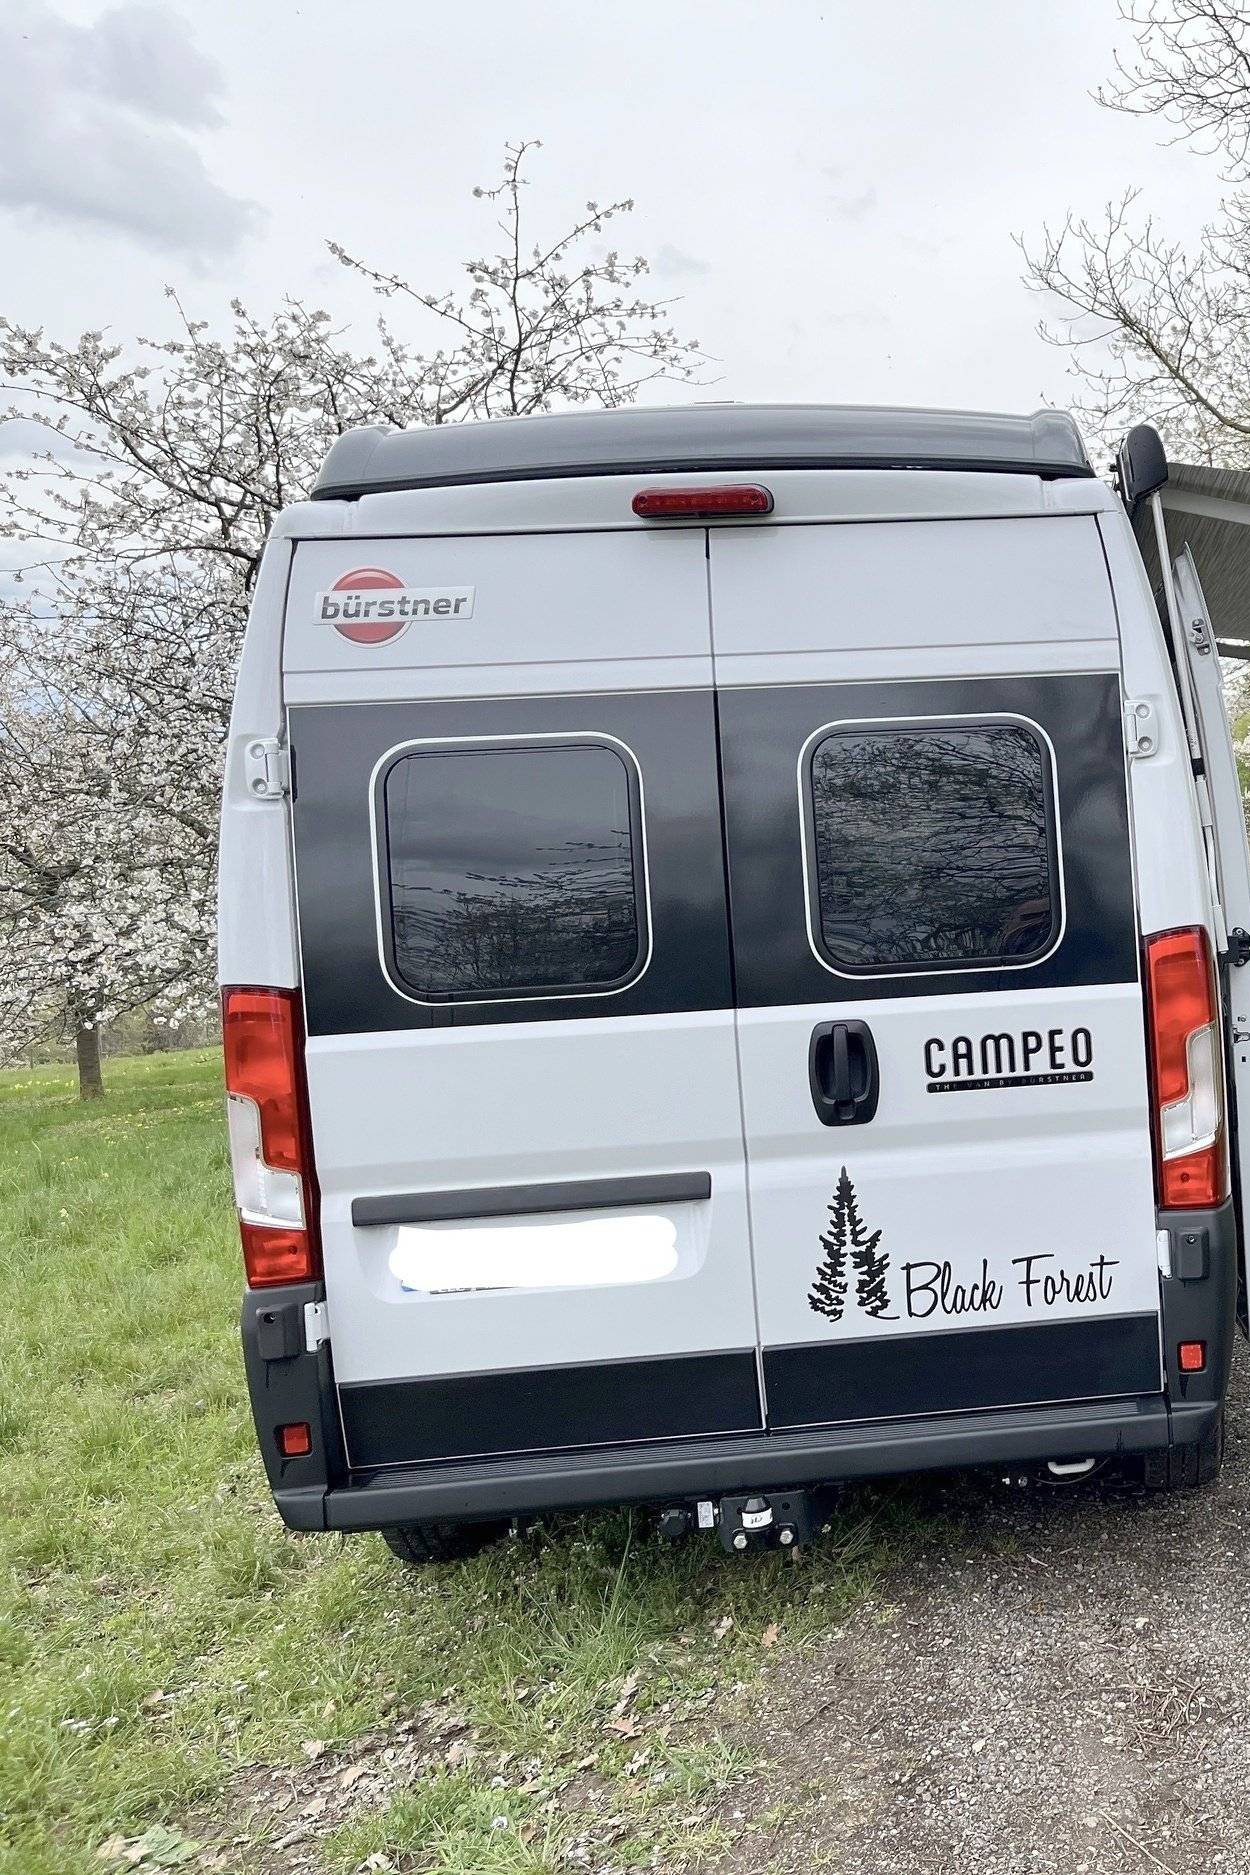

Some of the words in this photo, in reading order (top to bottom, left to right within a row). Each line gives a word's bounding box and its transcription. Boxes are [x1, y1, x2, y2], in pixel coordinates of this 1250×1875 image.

[321, 595, 468, 619] bürstner
[924, 1027, 1093, 1079] CAMPEO
[934, 1083, 957, 1092] THE
[967, 1080, 991, 1090] VAN
[901, 1258, 1004, 1319] Black
[1012, 1253, 1120, 1307] Forest
